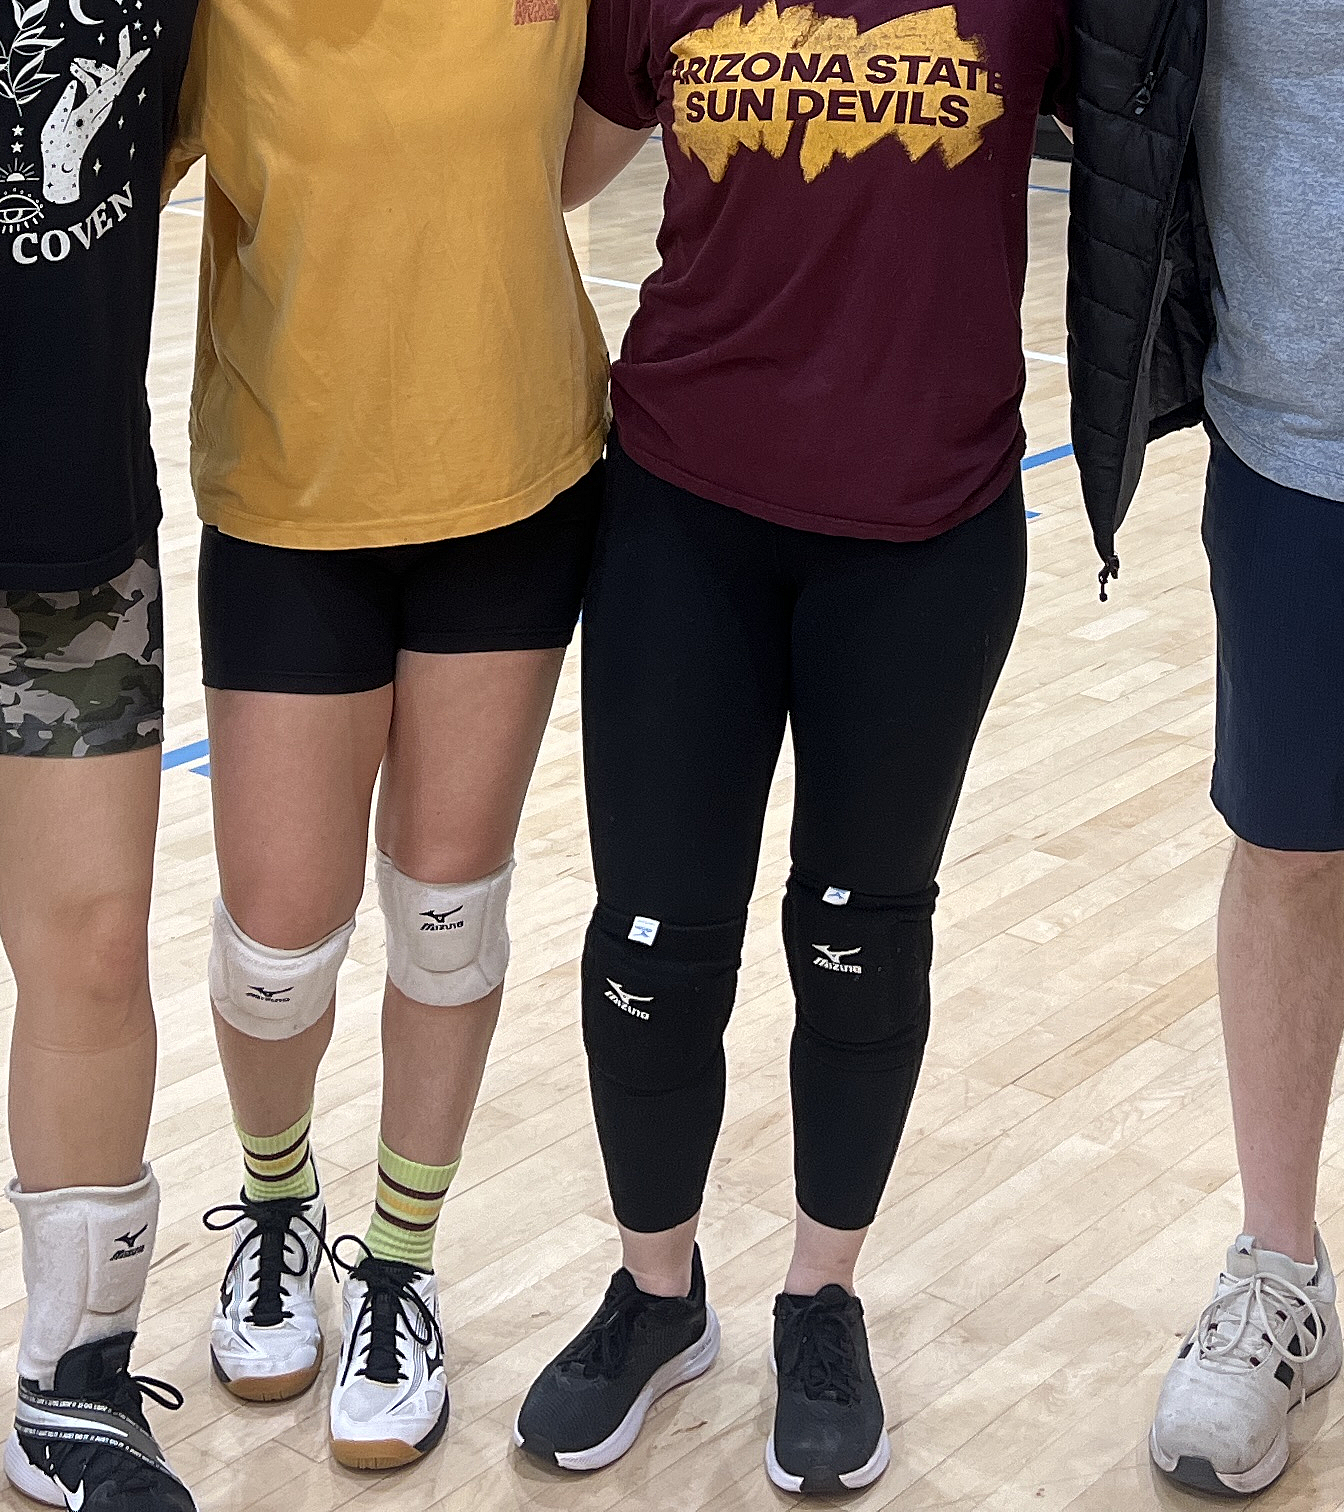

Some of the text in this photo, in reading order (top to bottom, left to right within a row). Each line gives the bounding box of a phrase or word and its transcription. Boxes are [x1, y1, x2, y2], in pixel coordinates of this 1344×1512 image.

[673, 51, 1003, 95] ARIZONA STATE
[685, 88, 970, 129] SUN DEVILS
[11, 181, 136, 265] COVEN
